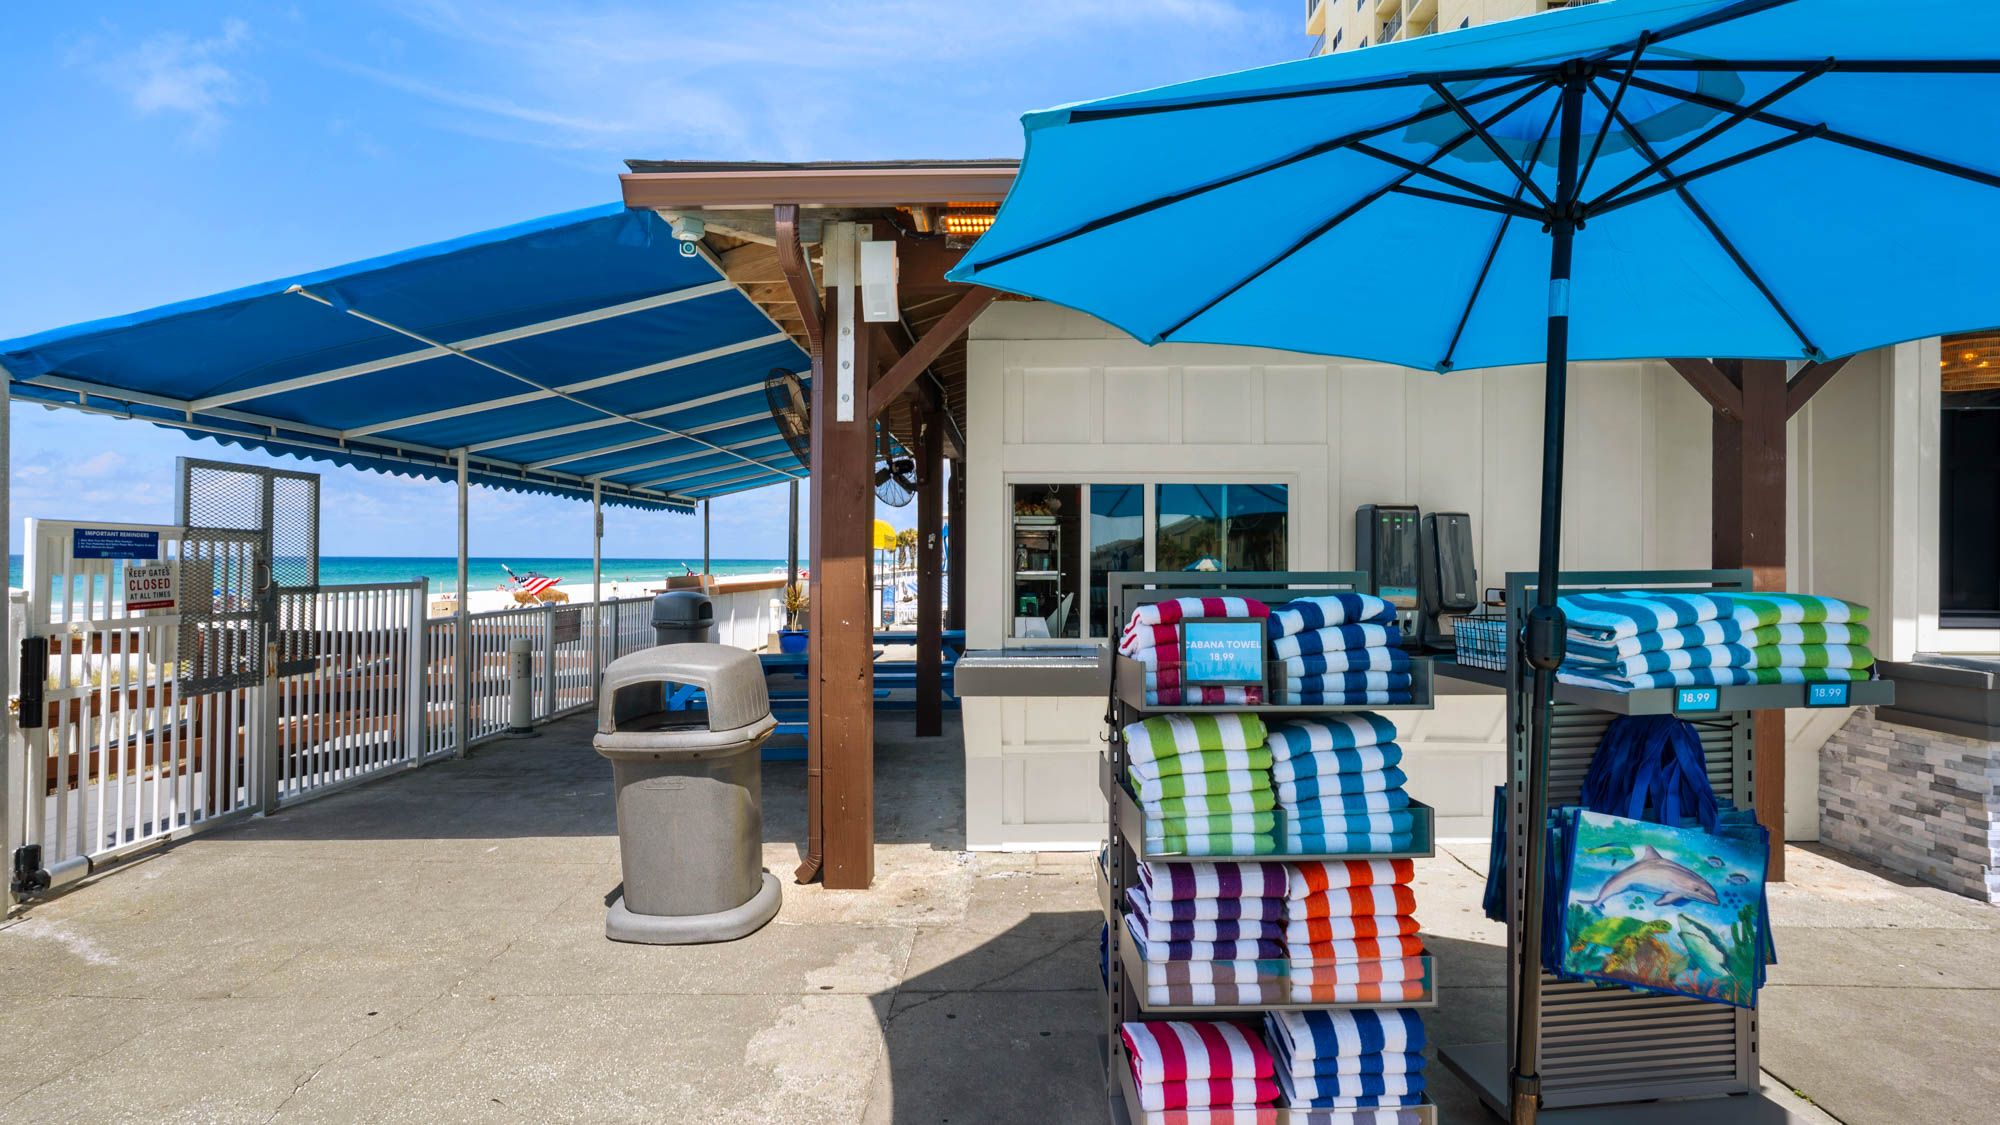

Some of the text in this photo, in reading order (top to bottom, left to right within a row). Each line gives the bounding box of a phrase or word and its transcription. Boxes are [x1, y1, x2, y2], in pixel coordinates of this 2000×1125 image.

[128, 568, 170, 578] KEEP GATES
[129, 578, 170, 591] CLOSED
[140, 592, 151, 600] ALL
[1226, 640, 1262, 649] TOWEL
[1210, 652, 1234, 661] 18.99
[1814, 688, 1842, 697] 18.99
[1682, 693, 1710, 703] 18.99
